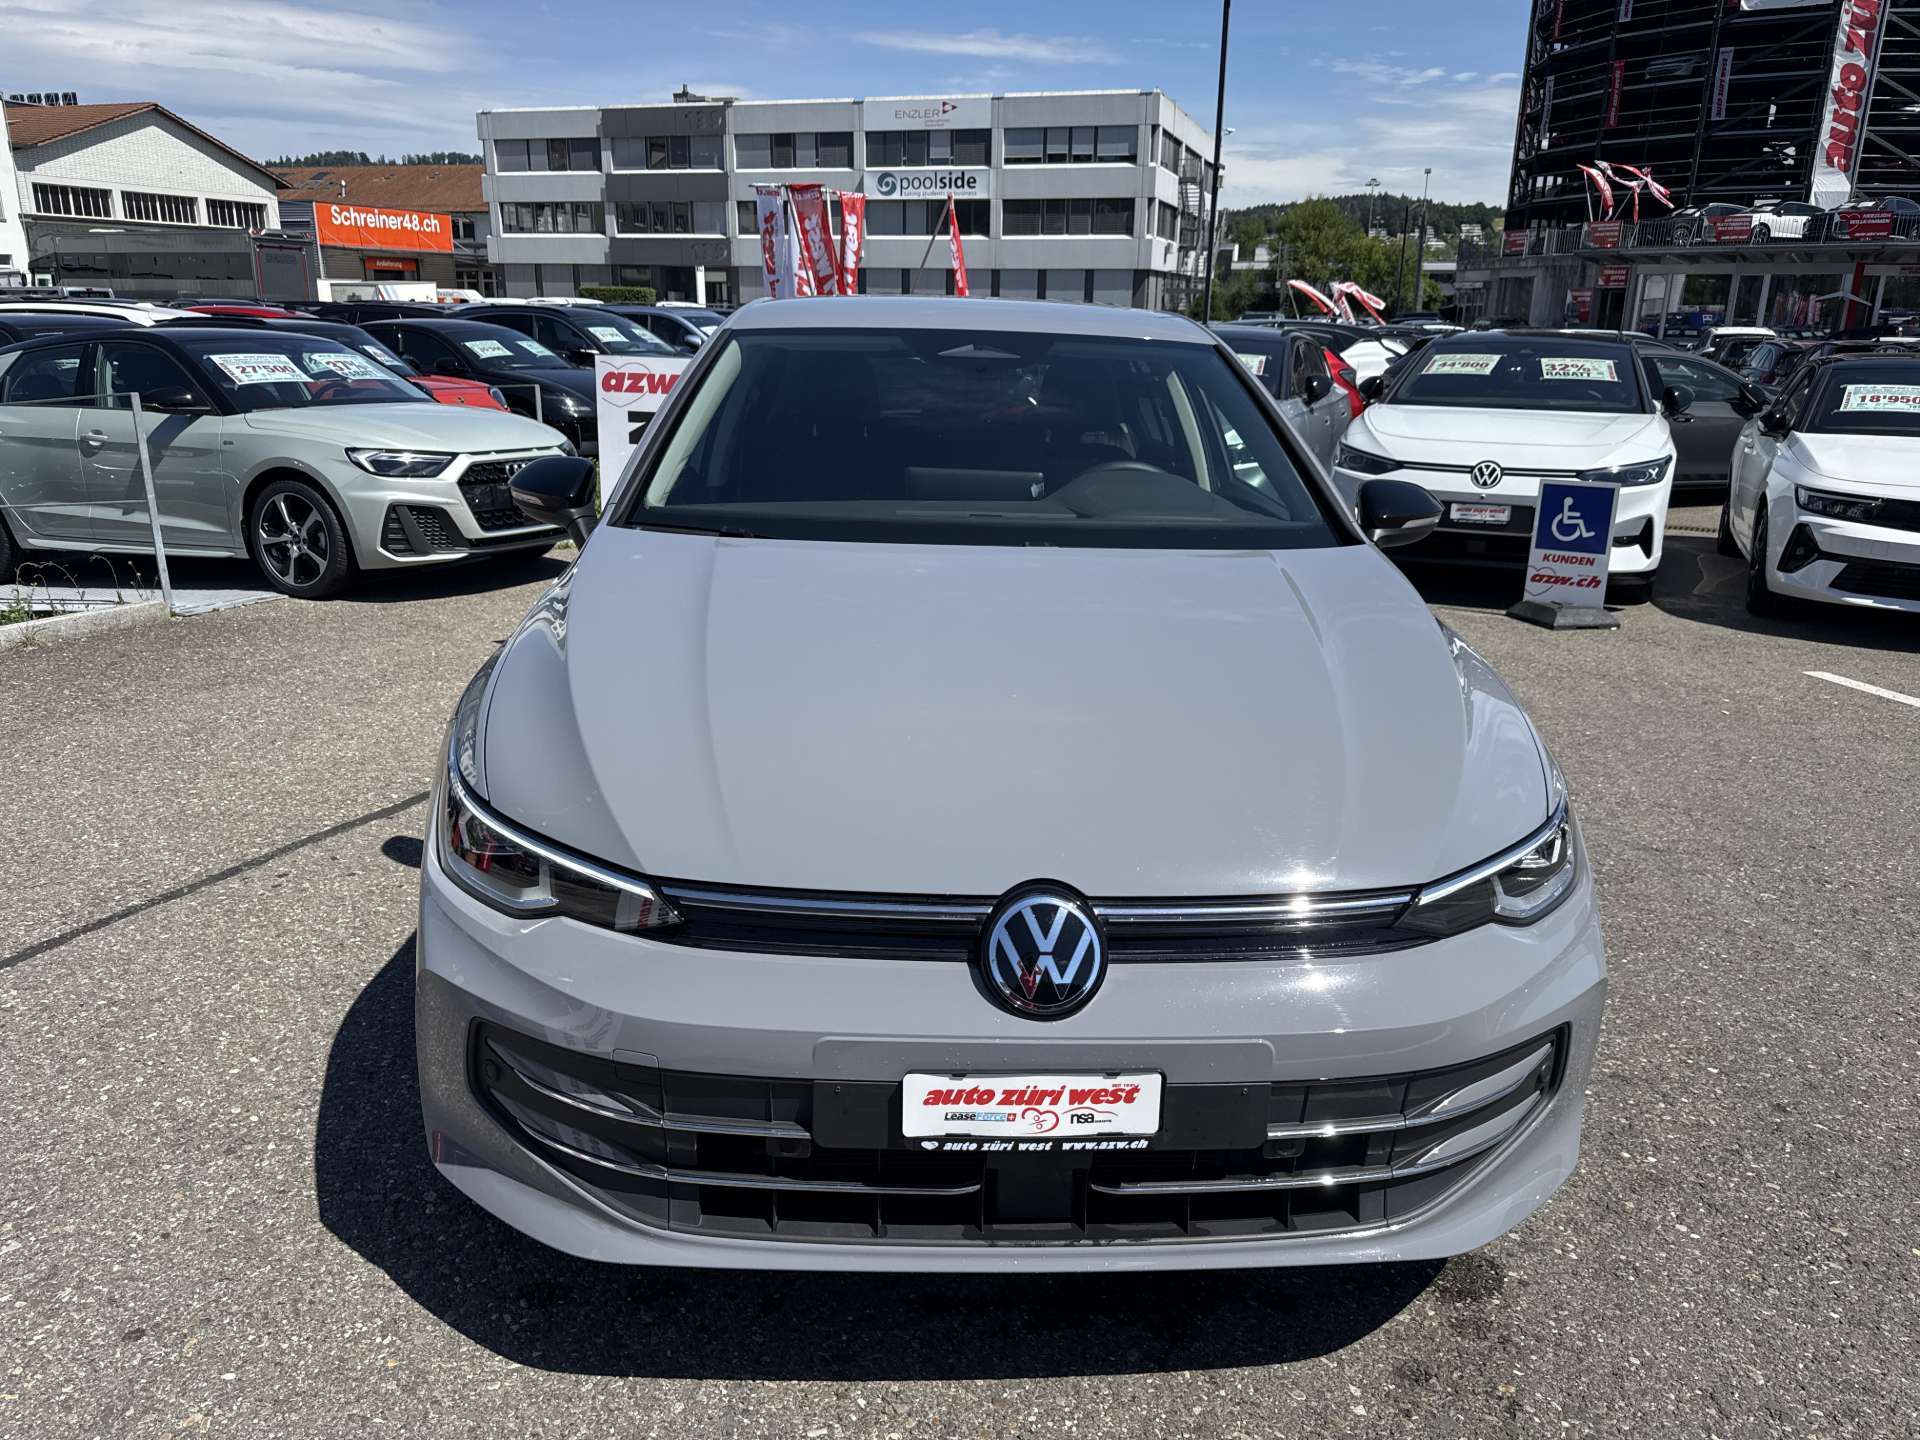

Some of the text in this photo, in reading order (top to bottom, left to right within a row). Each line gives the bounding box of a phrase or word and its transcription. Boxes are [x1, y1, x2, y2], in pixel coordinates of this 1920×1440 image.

[894, 109, 940, 119] ENZLER
[1826, 62, 1867, 173] auto
[900, 171, 977, 196] poolside
[331, 205, 440, 233] Schreiner48.ch
[236, 365, 296, 374] 27'500
[1545, 363, 1591, 372] 32%
[1542, 553, 1596, 566] KUNDEN
[1530, 573, 1601, 589] azw.ch
[923, 1084, 1142, 1106] auto züri west
[944, 1111, 1006, 1122] LeaseForce
[1070, 1112, 1095, 1125] nsa
[943, 1139, 1149, 1151] auto züri west www.azw.ch
